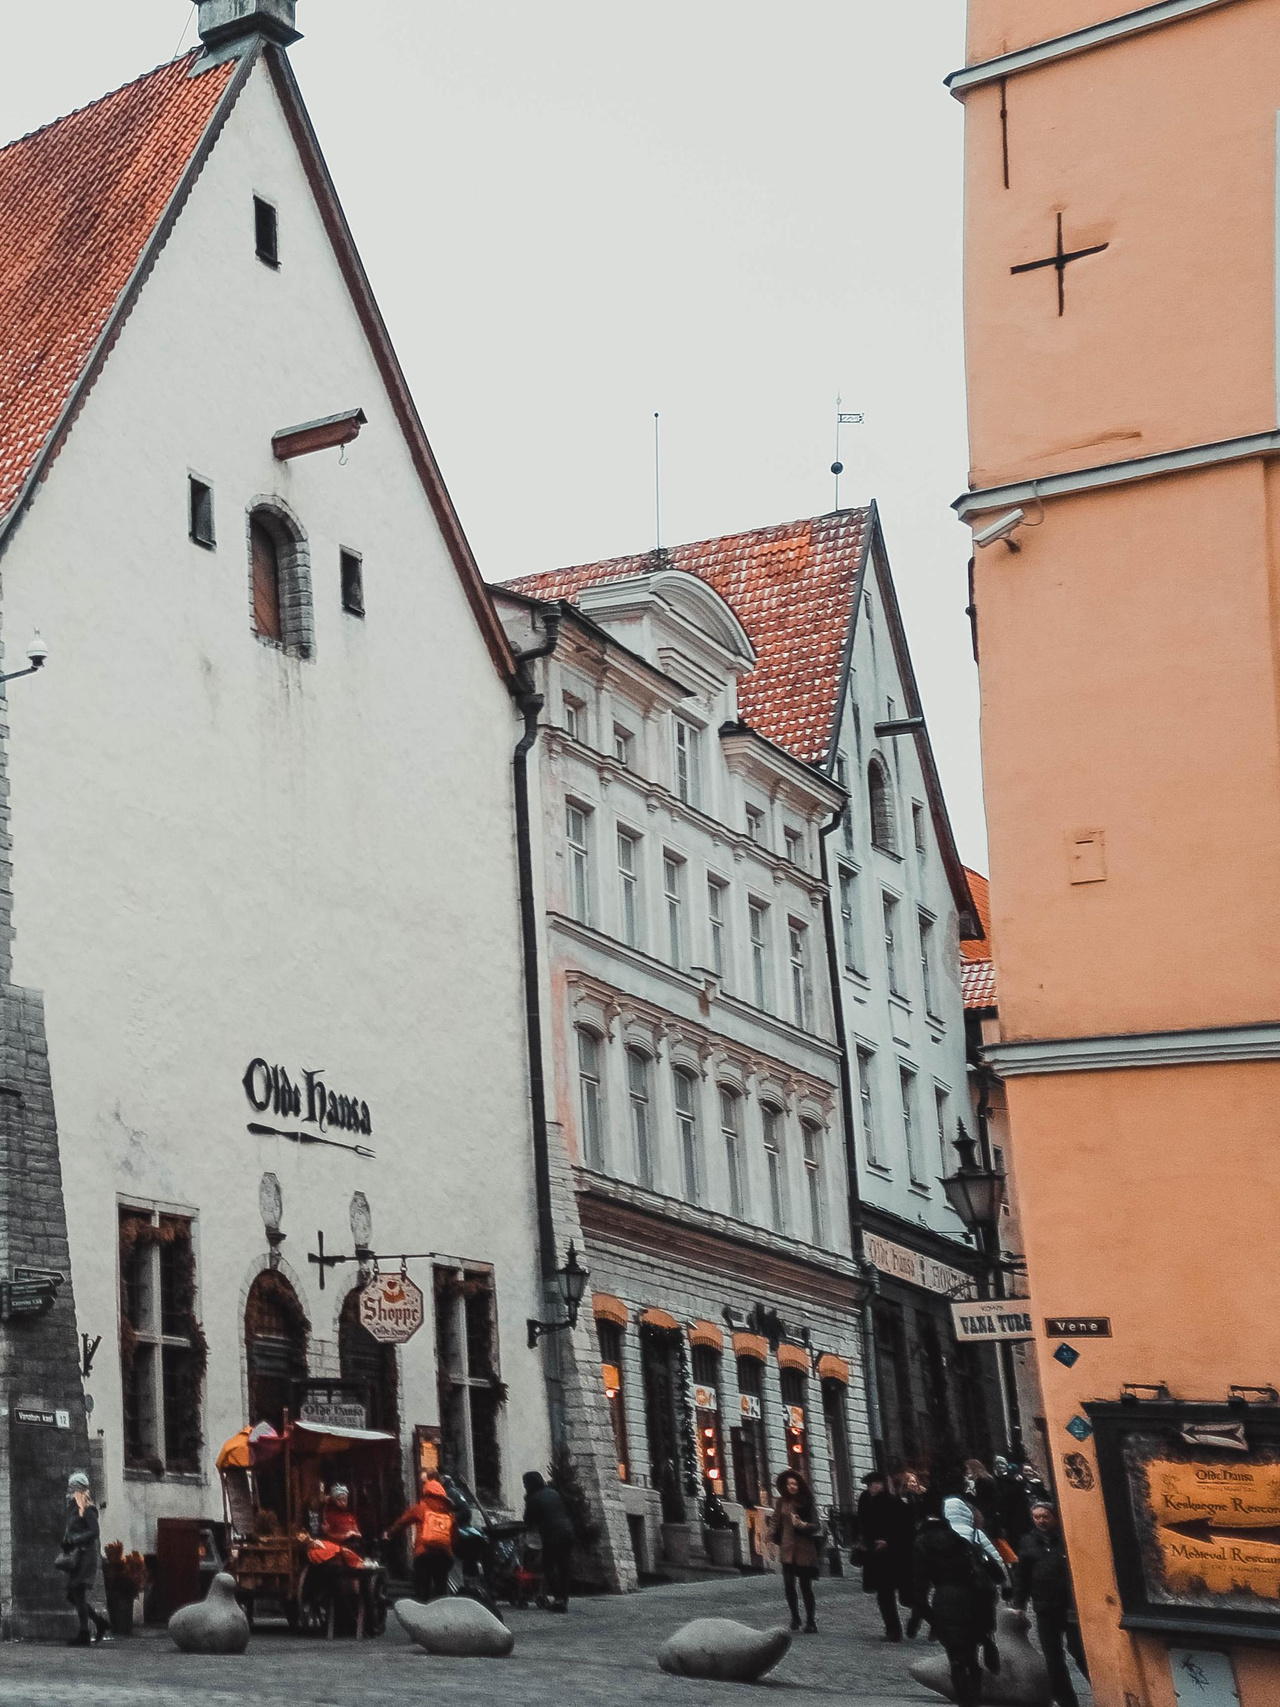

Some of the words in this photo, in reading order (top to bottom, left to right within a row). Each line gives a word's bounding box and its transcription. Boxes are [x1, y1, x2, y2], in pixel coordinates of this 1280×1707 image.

[363, 1296, 420, 1327] Shoppe
[960, 1315, 997, 1334] VANA
[997, 1312, 1032, 1333] TURG
[1057, 1321, 1098, 1331] Vene
[1162, 1493, 1228, 1515] Keskaegne
[1170, 1544, 1227, 1561] Medieval
